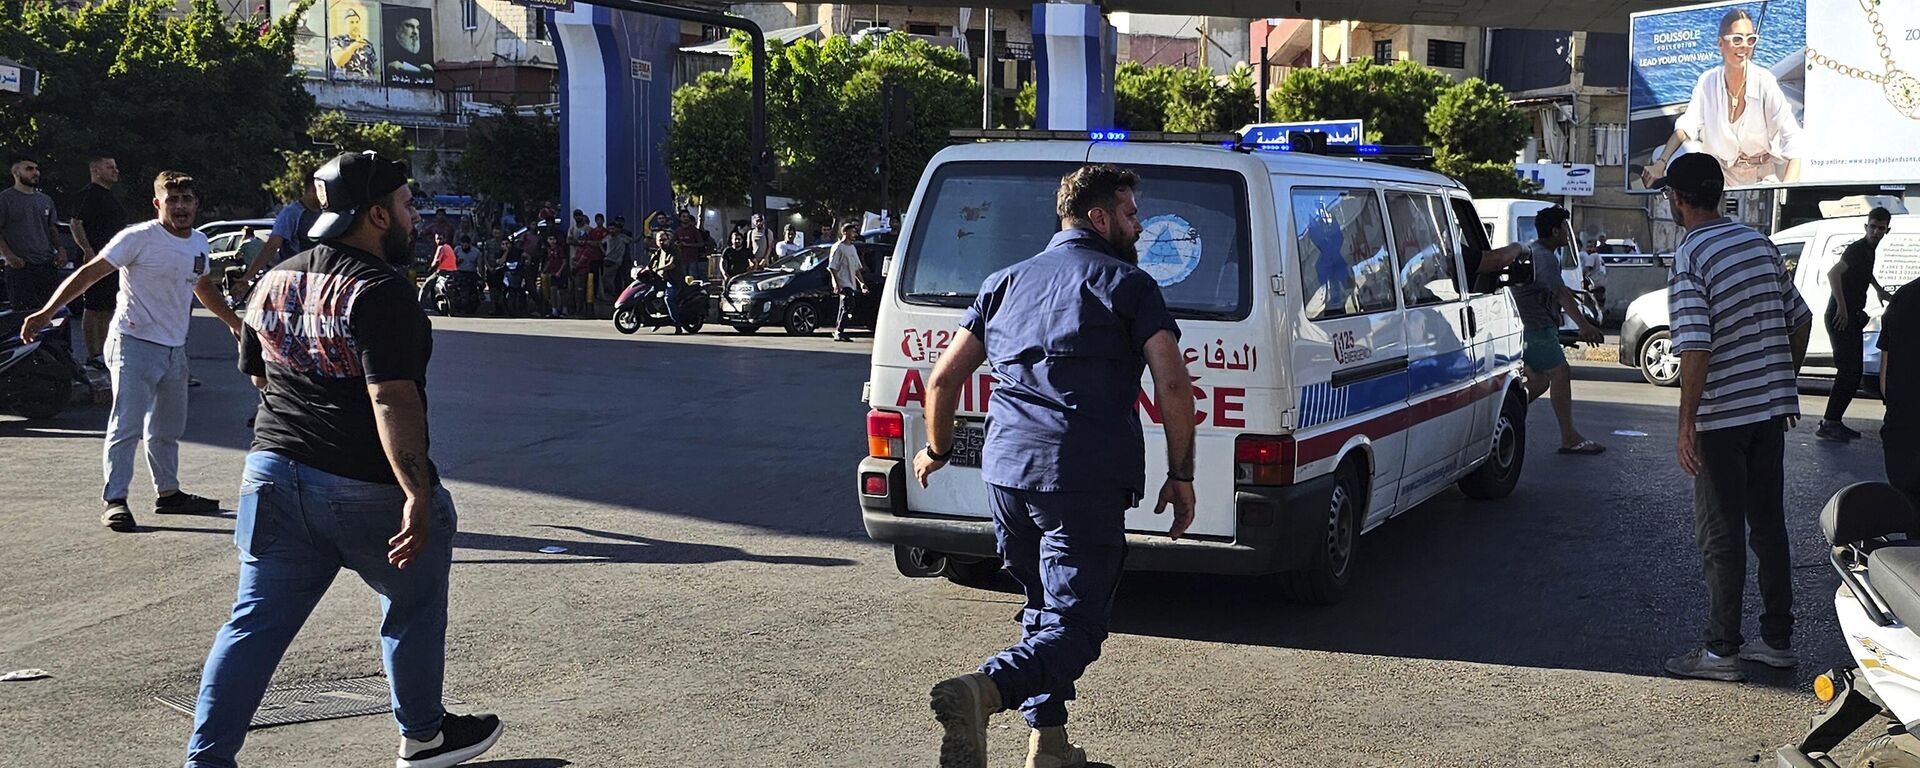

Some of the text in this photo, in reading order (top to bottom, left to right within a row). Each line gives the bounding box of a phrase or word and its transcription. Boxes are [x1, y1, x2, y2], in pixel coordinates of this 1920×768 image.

[1653, 29, 1701, 44] BOUSSOLE
[1656, 41, 1697, 51] COLLECTION
[1639, 52, 1714, 67] LEAD YOUR OWN WAY
[922, 329, 957, 348] 12
[1339, 330, 1355, 350] 125
